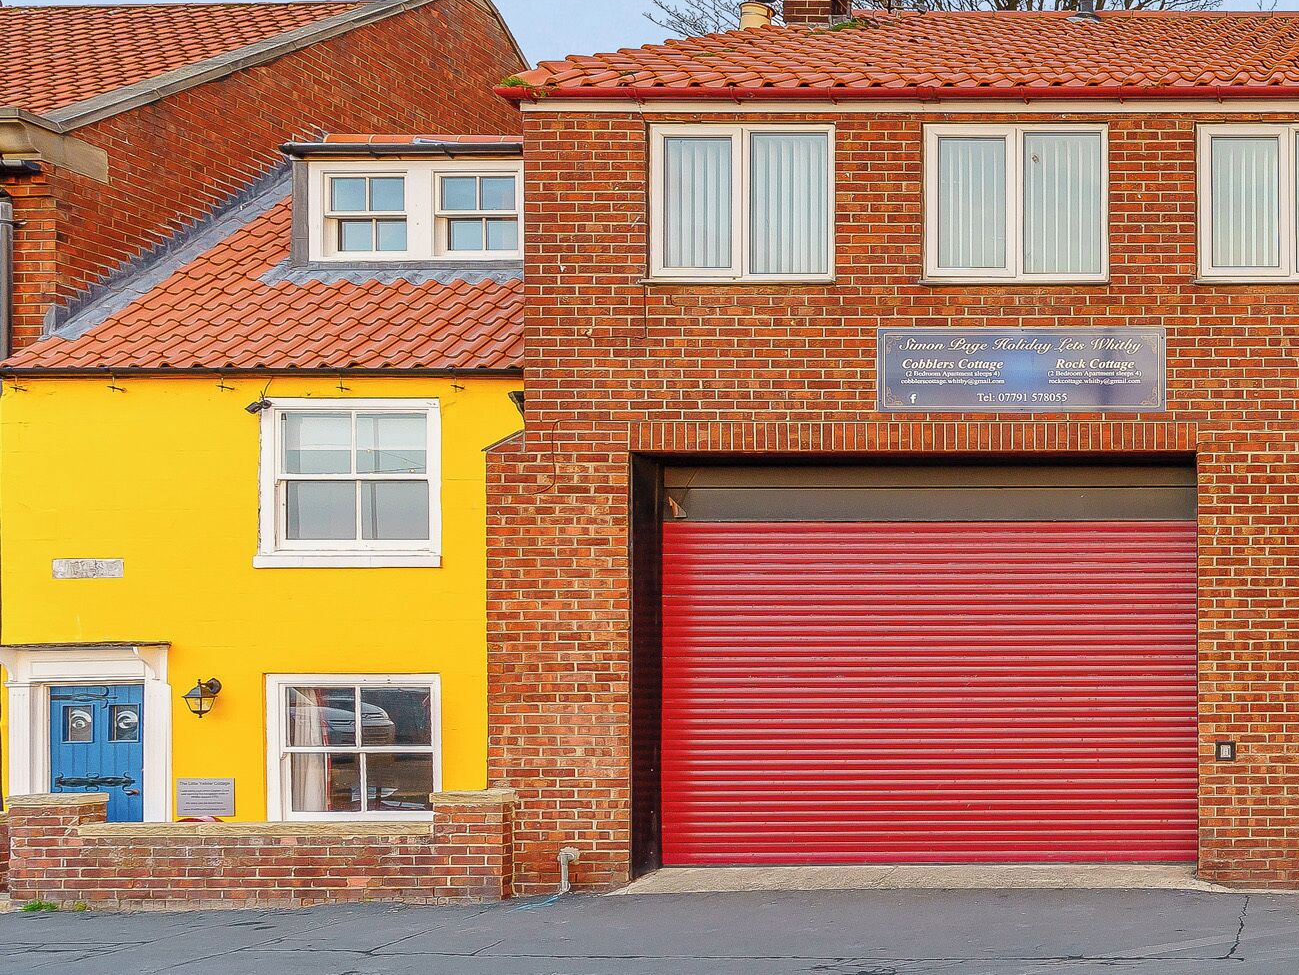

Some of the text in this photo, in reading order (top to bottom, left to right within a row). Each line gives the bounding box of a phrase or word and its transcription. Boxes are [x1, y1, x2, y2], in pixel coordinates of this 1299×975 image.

[899, 337, 1144, 355] Simon Page Holiday Lets Whitby
[901, 358, 1004, 371] Cobblers Cottage
[1055, 358, 1135, 371] Rock Cottage
[977, 393, 1068, 402] Tel: 07791 578055
